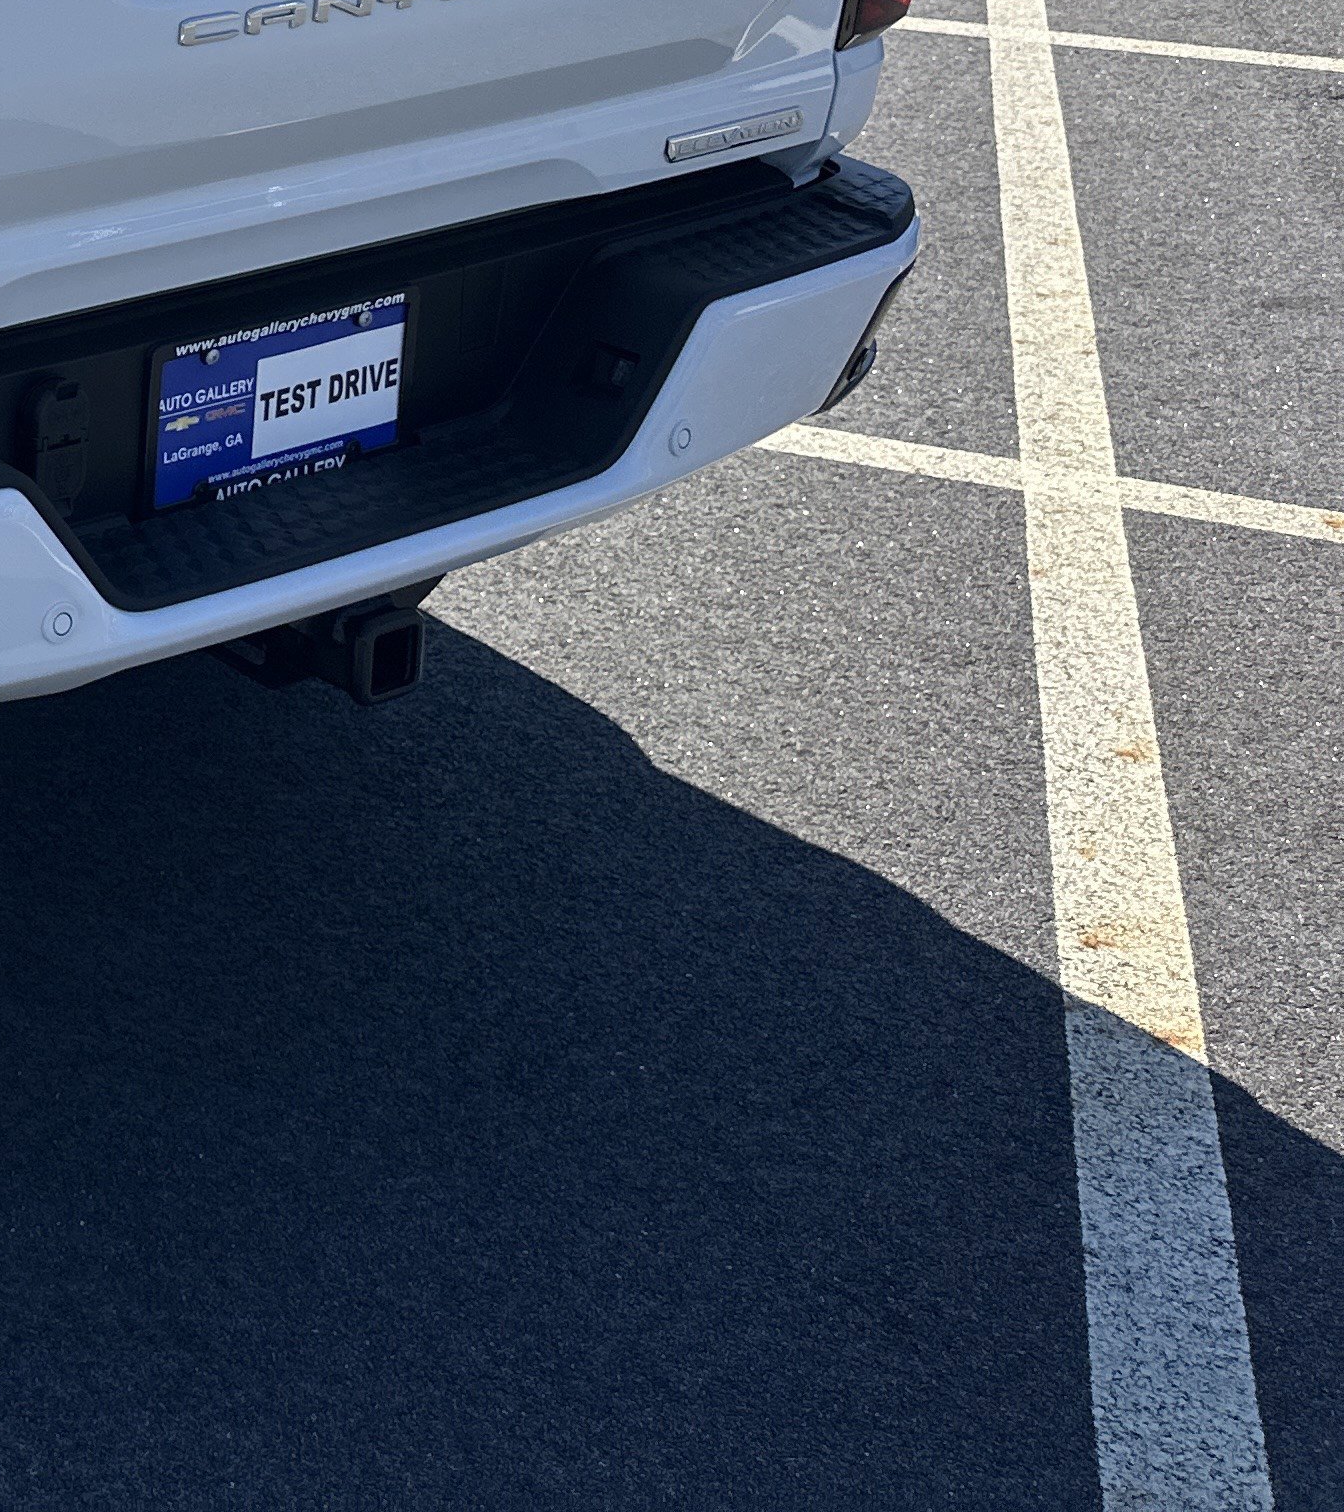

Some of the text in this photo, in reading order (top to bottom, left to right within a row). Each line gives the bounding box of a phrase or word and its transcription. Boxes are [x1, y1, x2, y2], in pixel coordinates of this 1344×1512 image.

[175, 293, 405, 357] www.autogallerychevygmc.com
[159, 377, 255, 412] AUTO GALLERY
[260, 358, 399, 421] TEST DRIVE
[163, 432, 243, 464] LaGrange, GA
